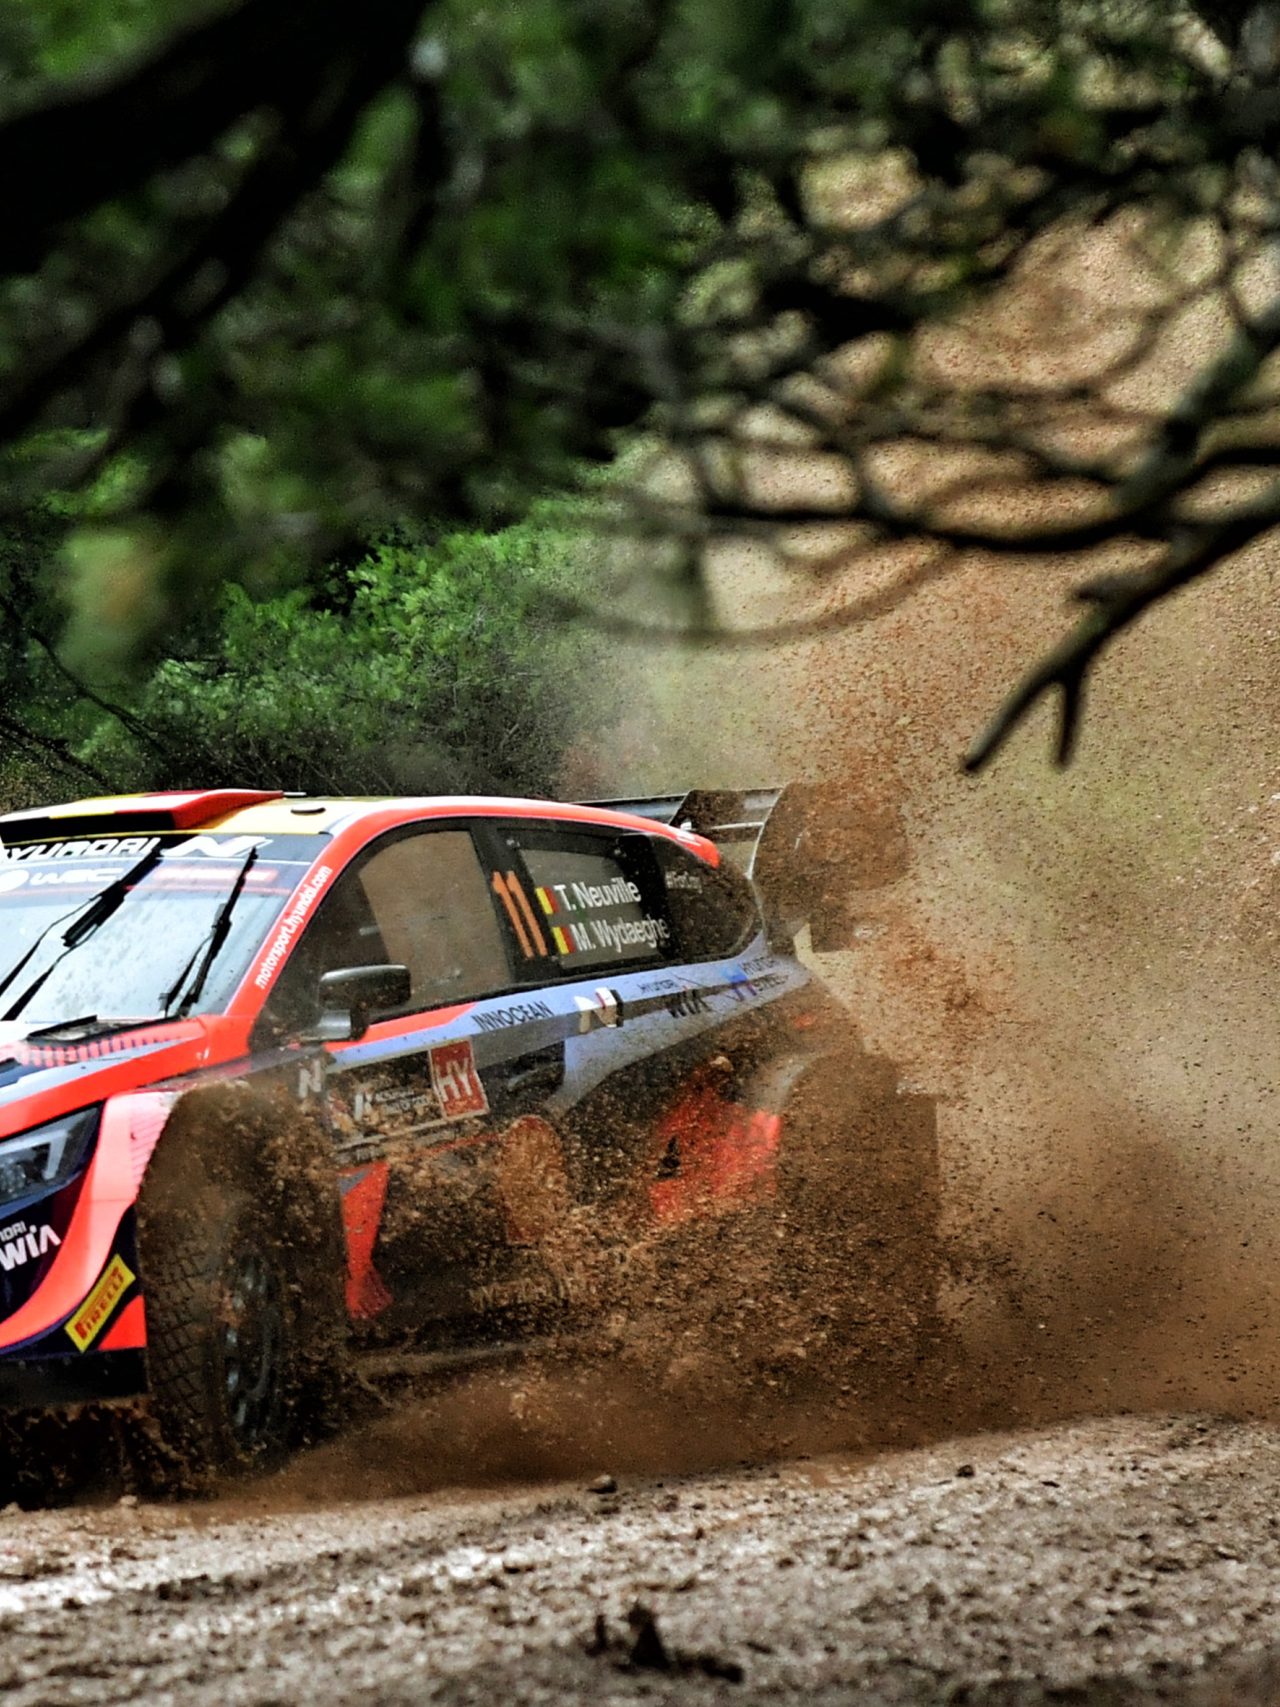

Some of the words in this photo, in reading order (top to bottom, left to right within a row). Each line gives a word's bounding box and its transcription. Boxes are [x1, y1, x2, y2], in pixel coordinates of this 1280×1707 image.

[0, 836, 162, 862] YUNDAI
[553, 883, 577, 912] T.
[578, 875, 643, 910] Neuville
[254, 865, 334, 990] motorsport.hyundai.com
[491, 870, 548, 960] 11
[570, 925, 596, 952] M.
[471, 1000, 555, 1033] INNOCEAN
